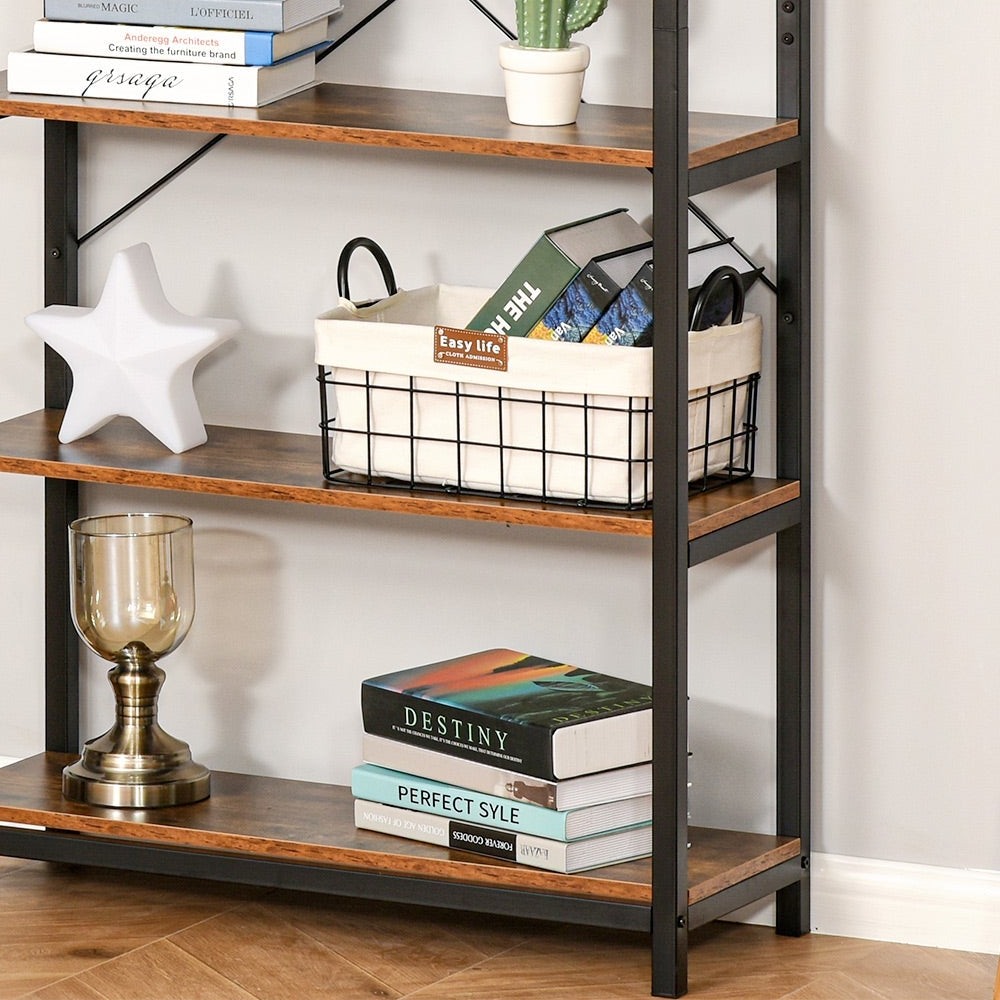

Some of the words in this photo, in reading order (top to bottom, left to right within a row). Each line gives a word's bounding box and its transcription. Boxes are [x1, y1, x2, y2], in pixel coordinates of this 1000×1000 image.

[101, 2, 138, 13] MAGIC
[190, 7, 254, 20] L'OFFICIEL
[124, 33, 169, 45] Anderegg
[172, 36, 219, 47] Architects
[108, 43, 148, 55] Creating
[150, 46, 165, 55] the
[167, 46, 207, 58] furniture
[209, 49, 236, 60] brand
[503, 281, 542, 322] THE
[440, 335, 473, 353] Easy
[476, 339, 501, 354] life
[445, 351, 464, 359] CLOTH
[465, 354, 496, 362] ADMISSION
[404, 706, 508, 751] DESTINY
[399, 786, 474, 814] PERFECT
[479, 802, 519, 824] SYLE
[453, 831, 484, 844] GODDESS
[485, 837, 513, 851] FOREVER
